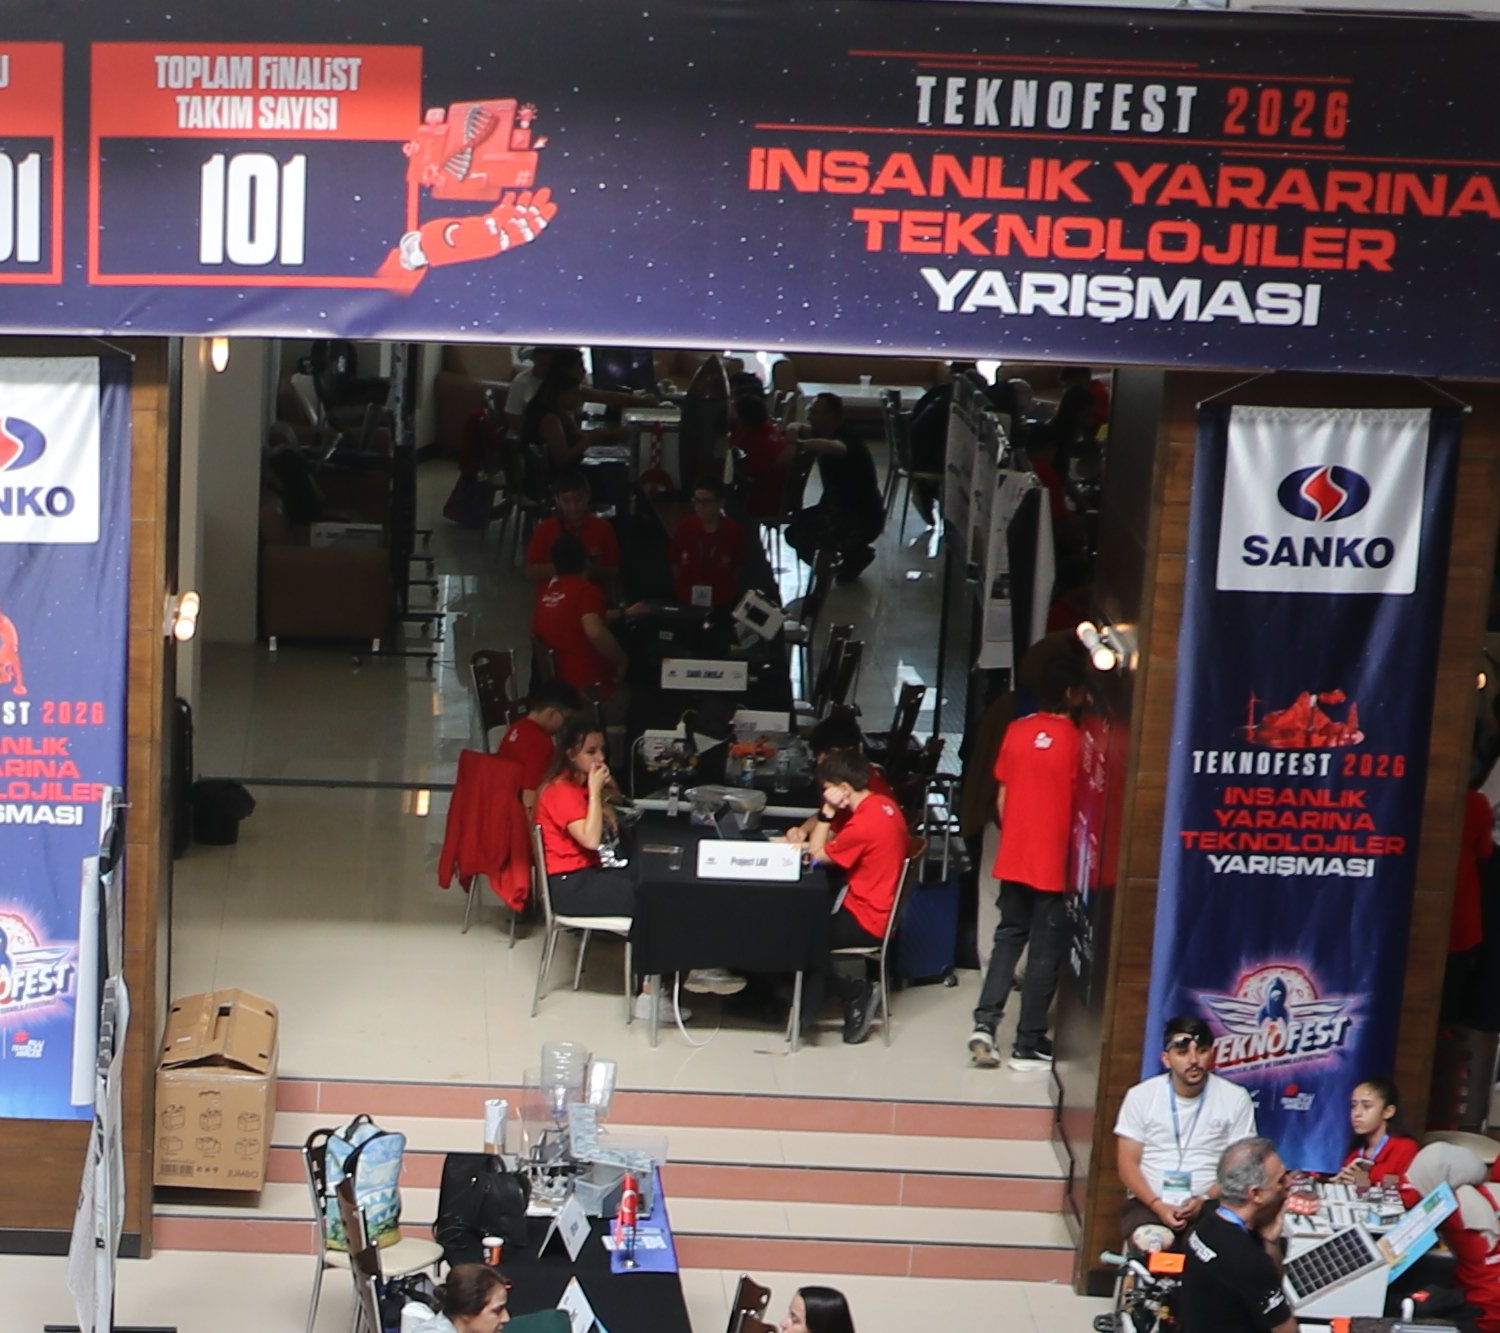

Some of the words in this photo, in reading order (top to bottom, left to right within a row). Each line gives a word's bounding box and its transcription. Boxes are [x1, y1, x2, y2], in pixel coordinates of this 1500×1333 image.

[155, 55, 254, 91] TOPLAM
[176, 95, 254, 129] TAKIM
[258, 96, 339, 131] SAYISI
[916, 75, 1198, 134] TEKNOFEST
[1222, 87, 1351, 139] 2026
[200, 152, 306, 266] 101
[920, 266, 1323, 328] YARIŞMASI
[1242, 535, 1395, 569] SANKO
[41, 701, 106, 725] 2026
[1192, 749, 1332, 777] TEKNOFEST
[1342, 753, 1407, 778] 2026
[1213, 809, 1376, 831] YARARINA
[1207, 854, 1375, 879] YARIŞMASI
[1211, 1015, 1351, 1066] EKNOFEST
